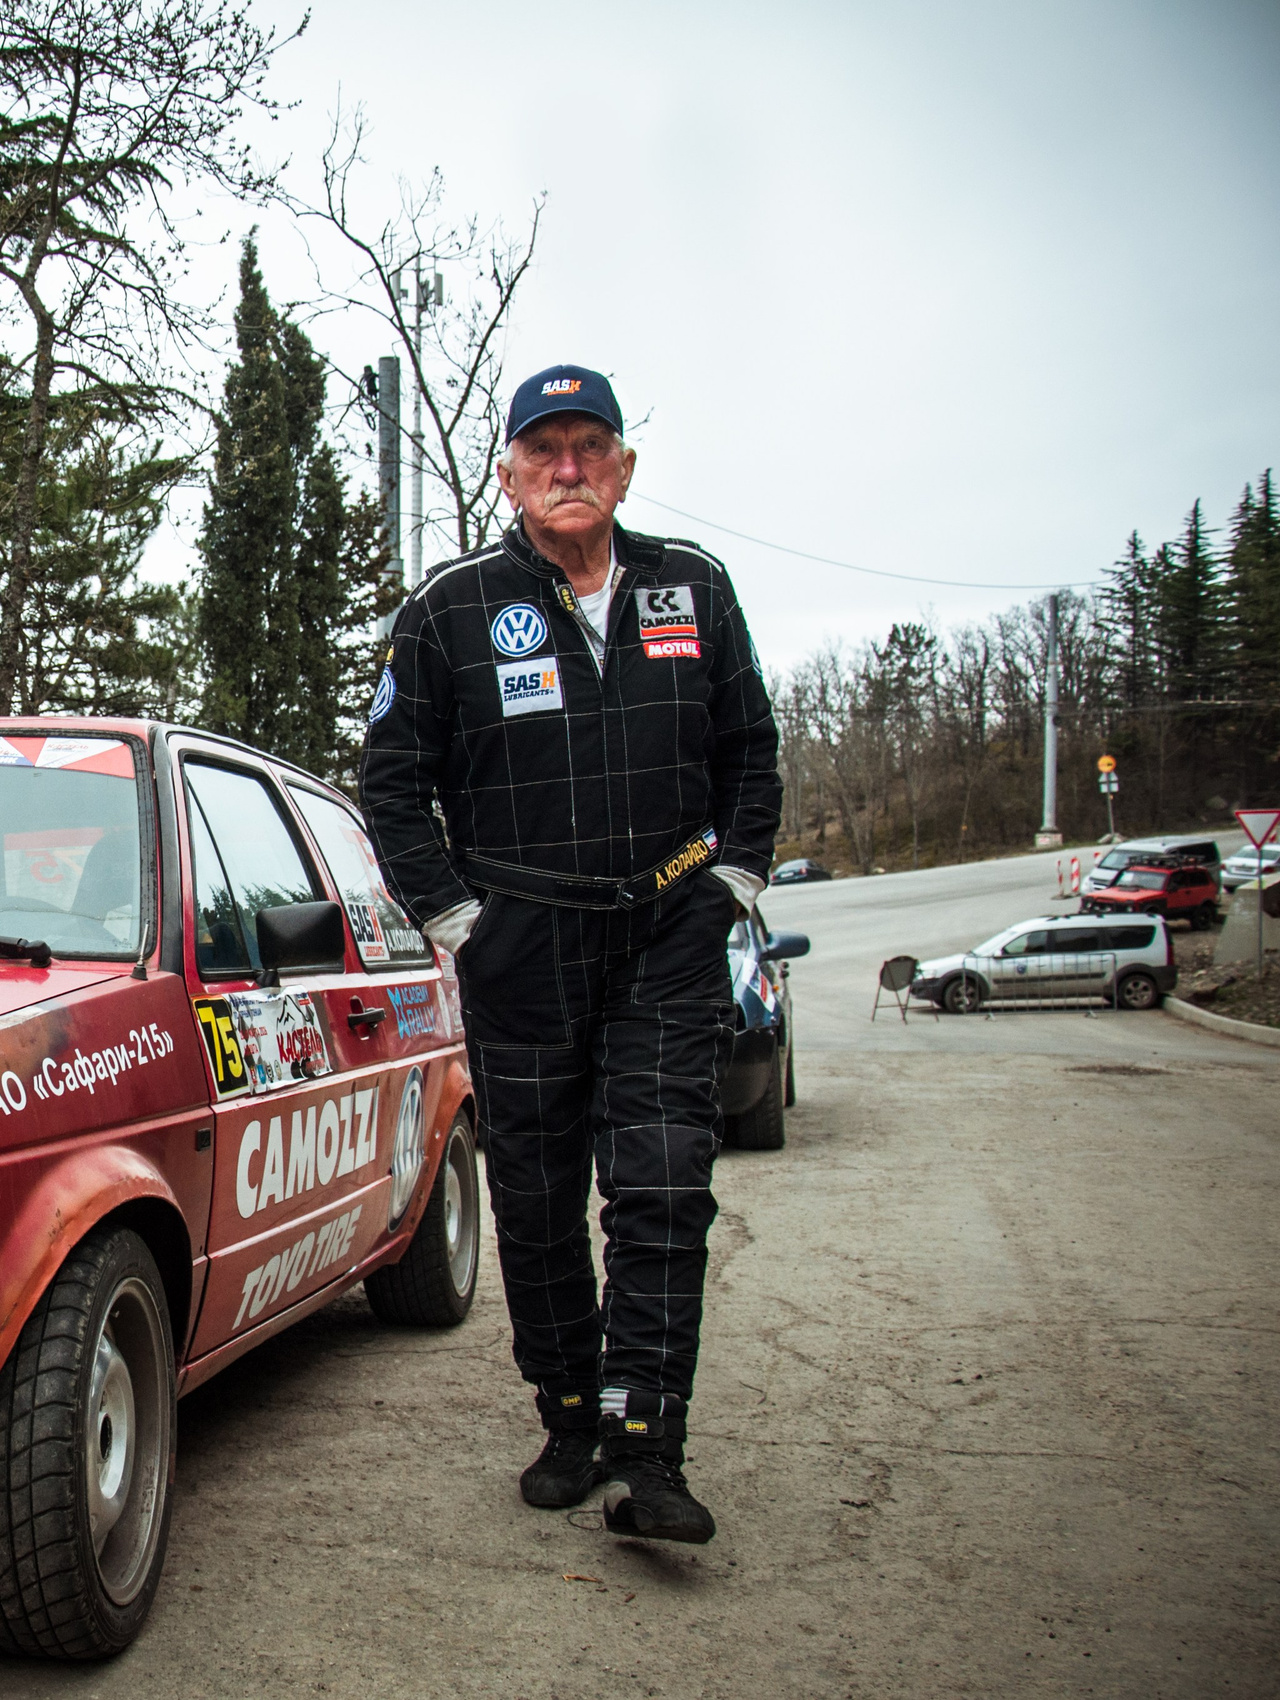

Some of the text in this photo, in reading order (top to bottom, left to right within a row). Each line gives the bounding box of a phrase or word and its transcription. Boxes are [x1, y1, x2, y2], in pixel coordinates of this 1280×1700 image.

[541, 379, 582, 394] SASH
[561, 587, 576, 611] OMP
[640, 614, 696, 628] CAMOZZI
[647, 641, 701, 657] MOTUL
[504, 671, 556, 694] SASH
[348, 904, 383, 943] SASH
[401, 985, 429, 1005] ACADEMY
[406, 1006, 436, 1037] RALLY
[197, 1006, 243, 1083] 75
[276, 1026, 323, 1065] КАСТЕЛЬ
[34, 1022, 174, 1101] «Сафари-215»
[237, 1086, 378, 1219] CAMOZZI
[562, 1397, 581, 1406] OMP
[626, 1422, 647, 1431] OMP
